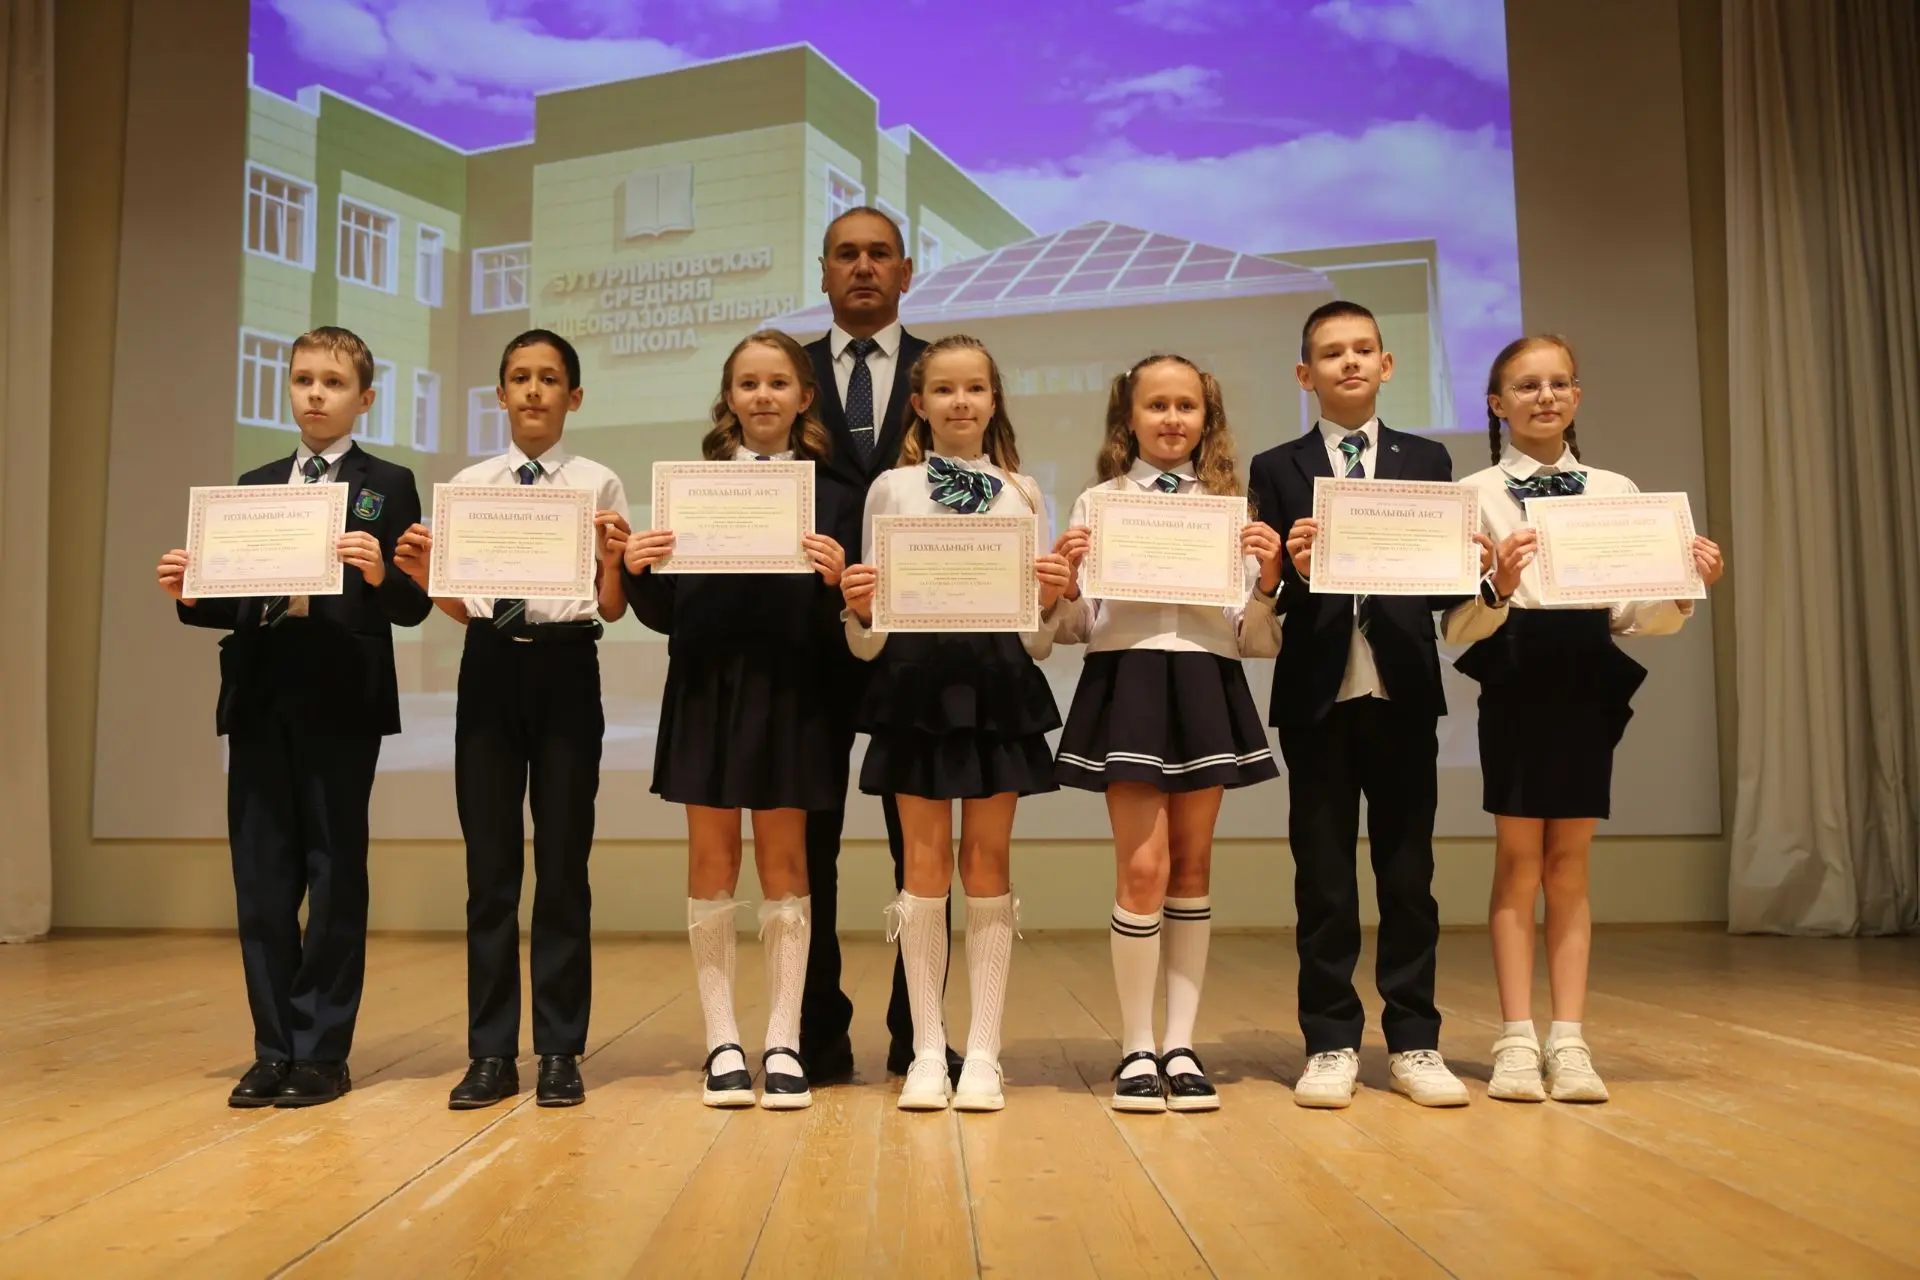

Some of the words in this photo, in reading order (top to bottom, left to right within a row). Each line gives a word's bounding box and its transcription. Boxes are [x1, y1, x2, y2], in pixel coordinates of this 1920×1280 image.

[553, 248, 772, 292] БУТУРЛИНОВСКАЯ
[601, 278, 712, 309] СРЕДНЯЯ
[536, 294, 796, 340] ЩЕОБРАЗОВАТЕЛЬНАЯ
[612, 329, 698, 354] ШКОЛА
